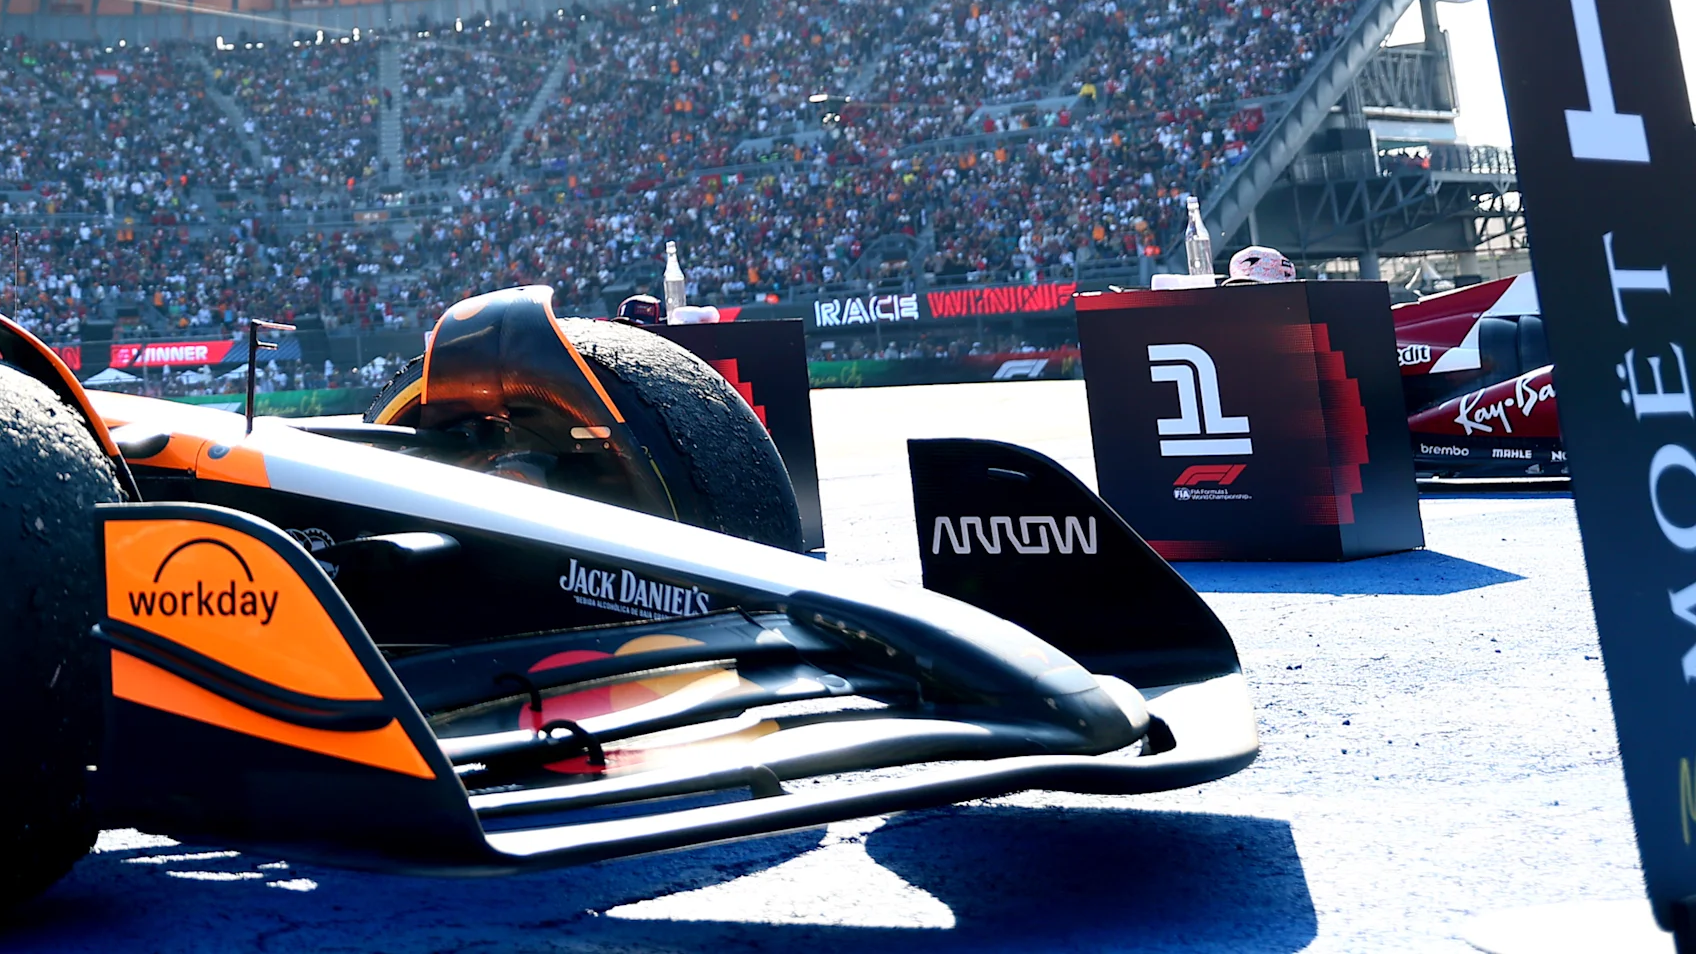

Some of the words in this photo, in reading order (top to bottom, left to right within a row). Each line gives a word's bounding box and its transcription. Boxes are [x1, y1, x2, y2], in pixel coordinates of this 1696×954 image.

[813, 293, 921, 327] RACE
[1147, 343, 1254, 457] 1
[1420, 443, 1470, 457] brembo
[1492, 448, 1532, 459] MAHLE
[128, 580, 279, 626] workday
